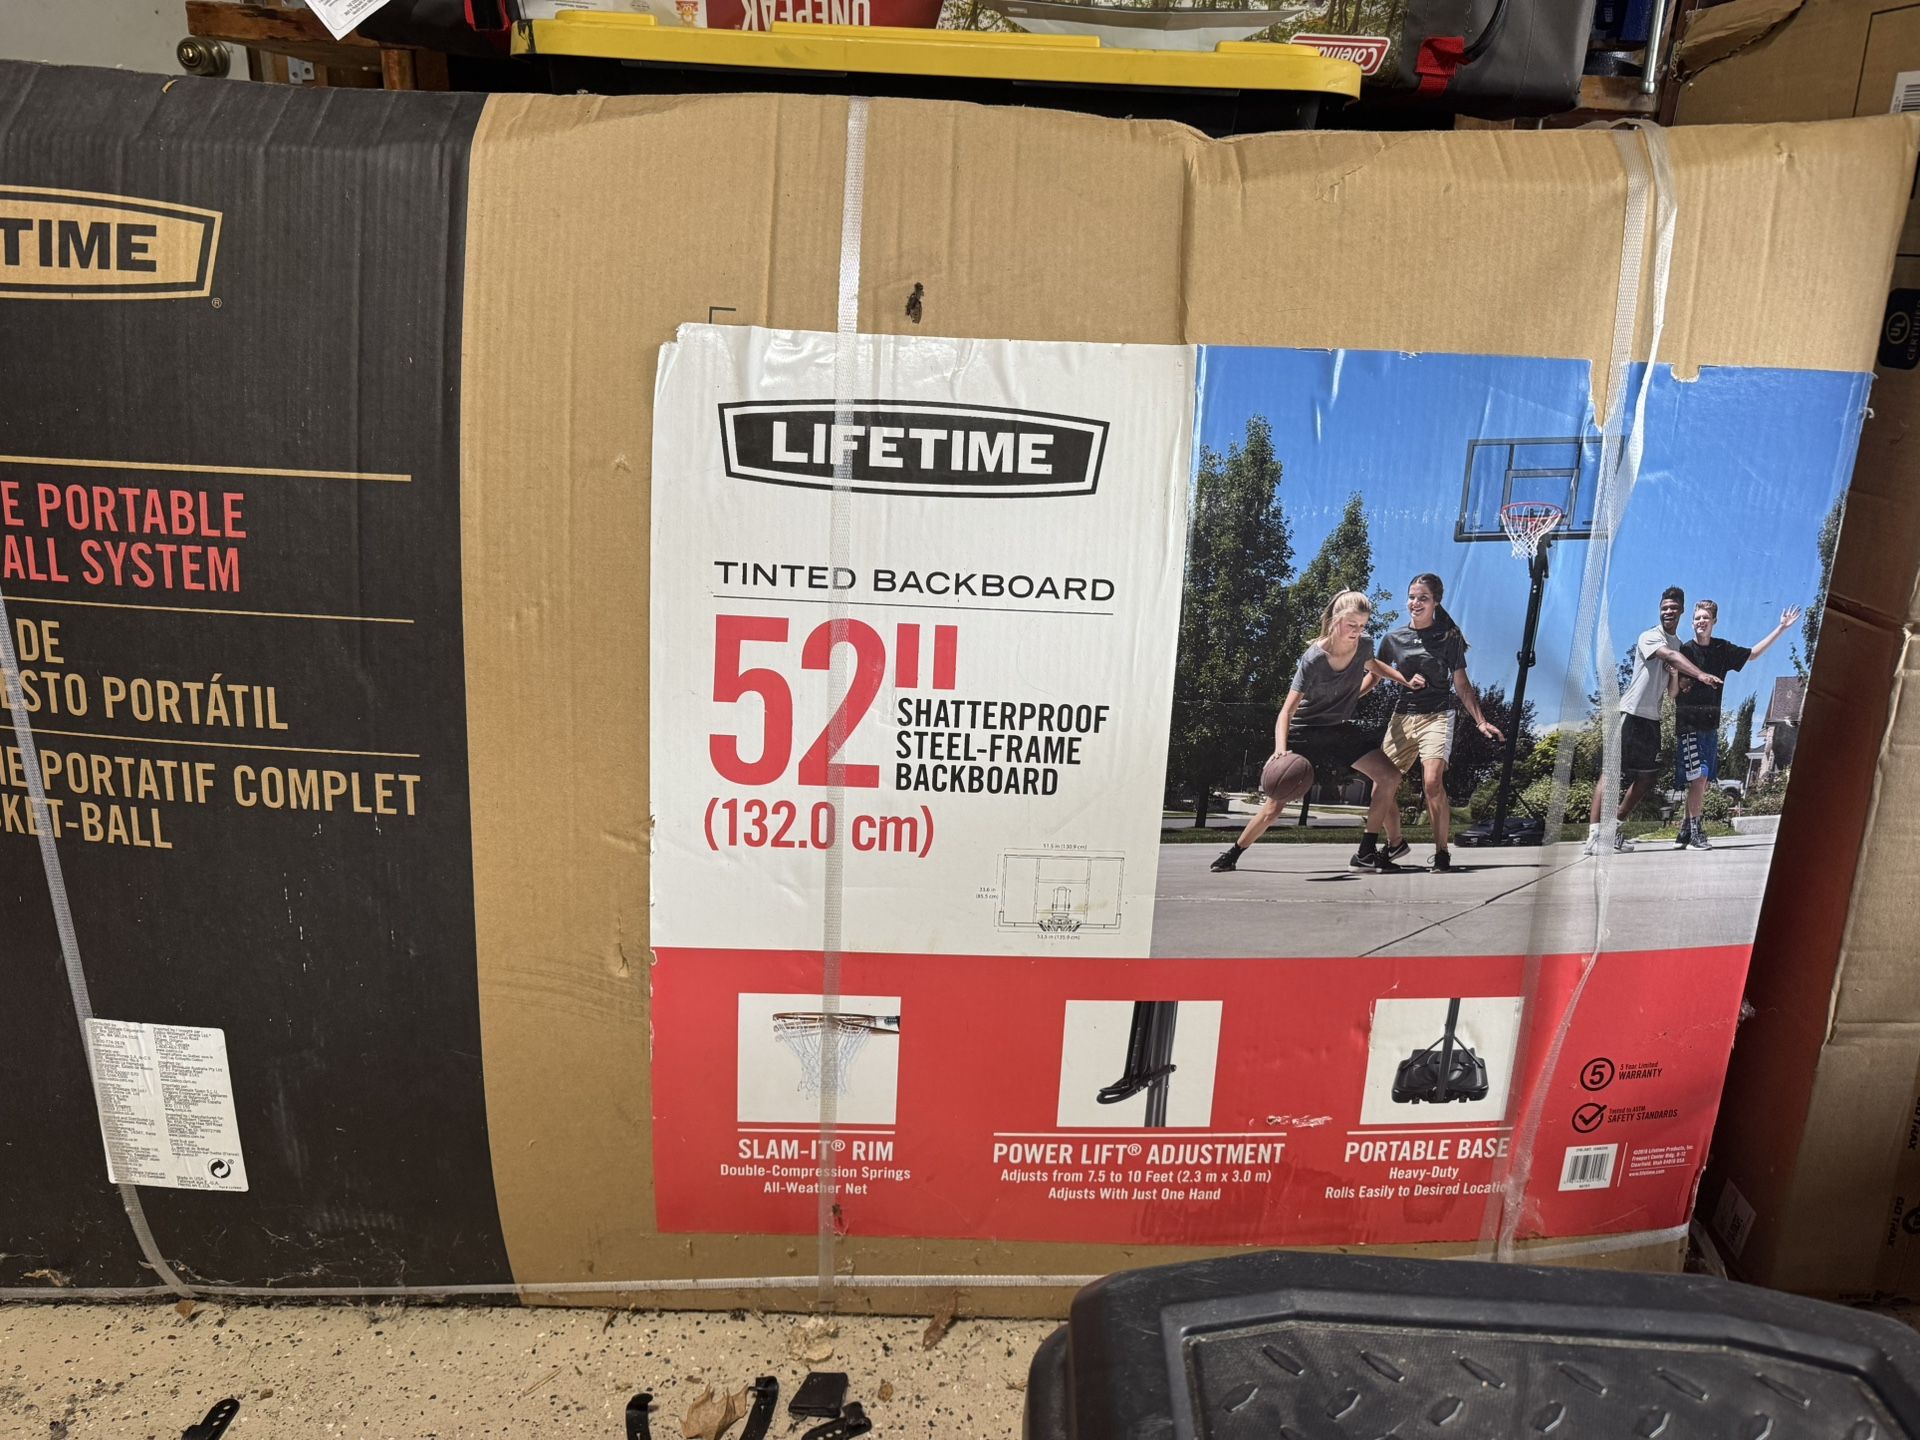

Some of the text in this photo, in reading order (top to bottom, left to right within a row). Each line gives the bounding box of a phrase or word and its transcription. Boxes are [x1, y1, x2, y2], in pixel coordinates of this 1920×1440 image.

[0, 217, 157, 272] TIME
[773, 421, 1053, 475] LIFETIME
[37, 482, 247, 539] PORTABLE
[3, 535, 240, 592] ALL SYSTEM
[713, 561, 1115, 601] TINTED BACKBOARD
[16, 618, 64, 664] DE
[102, 672, 288, 730] PORTÁTIL
[896, 697, 1110, 733] SHATTERPROOF
[896, 730, 1082, 766] STEEL-FRAME
[40, 749, 216, 803] PORTATIF
[233, 765, 421, 815] COMPLET
[896, 763, 1059, 796] BACKBOARD
[0, 793, 173, 848] KET-BALL
[703, 797, 934, 858] (132.0 cm)
[1618, 1068, 1663, 1080] WARRANTY
[1620, 1063, 1625, 1071] 5
[1638, 1061, 1658, 1069] Limited
[1607, 1109, 1678, 1124] SAFETY STANDARDS
[852, 1141, 893, 1161] RIM
[993, 1143, 1072, 1165] POWER
[1146, 1142, 1286, 1165] ADJUSTMENT
[1344, 1137, 1511, 1163] PORTABLE BASE
[720, 1164, 911, 1181] Double-Compression Springs
[764, 1181, 868, 1195] All-Weather Net
[1001, 1169, 1272, 1184] Adjusts from 7.5 to 10 Feet (2.3 m x 3.0 m)
[1389, 1165, 1459, 1181] Heavy-Duty
[1048, 1187, 1221, 1200] Adjusts With Just One Hand
[1325, 1180, 1507, 1200] Rolls Easily to Desired Locatio
